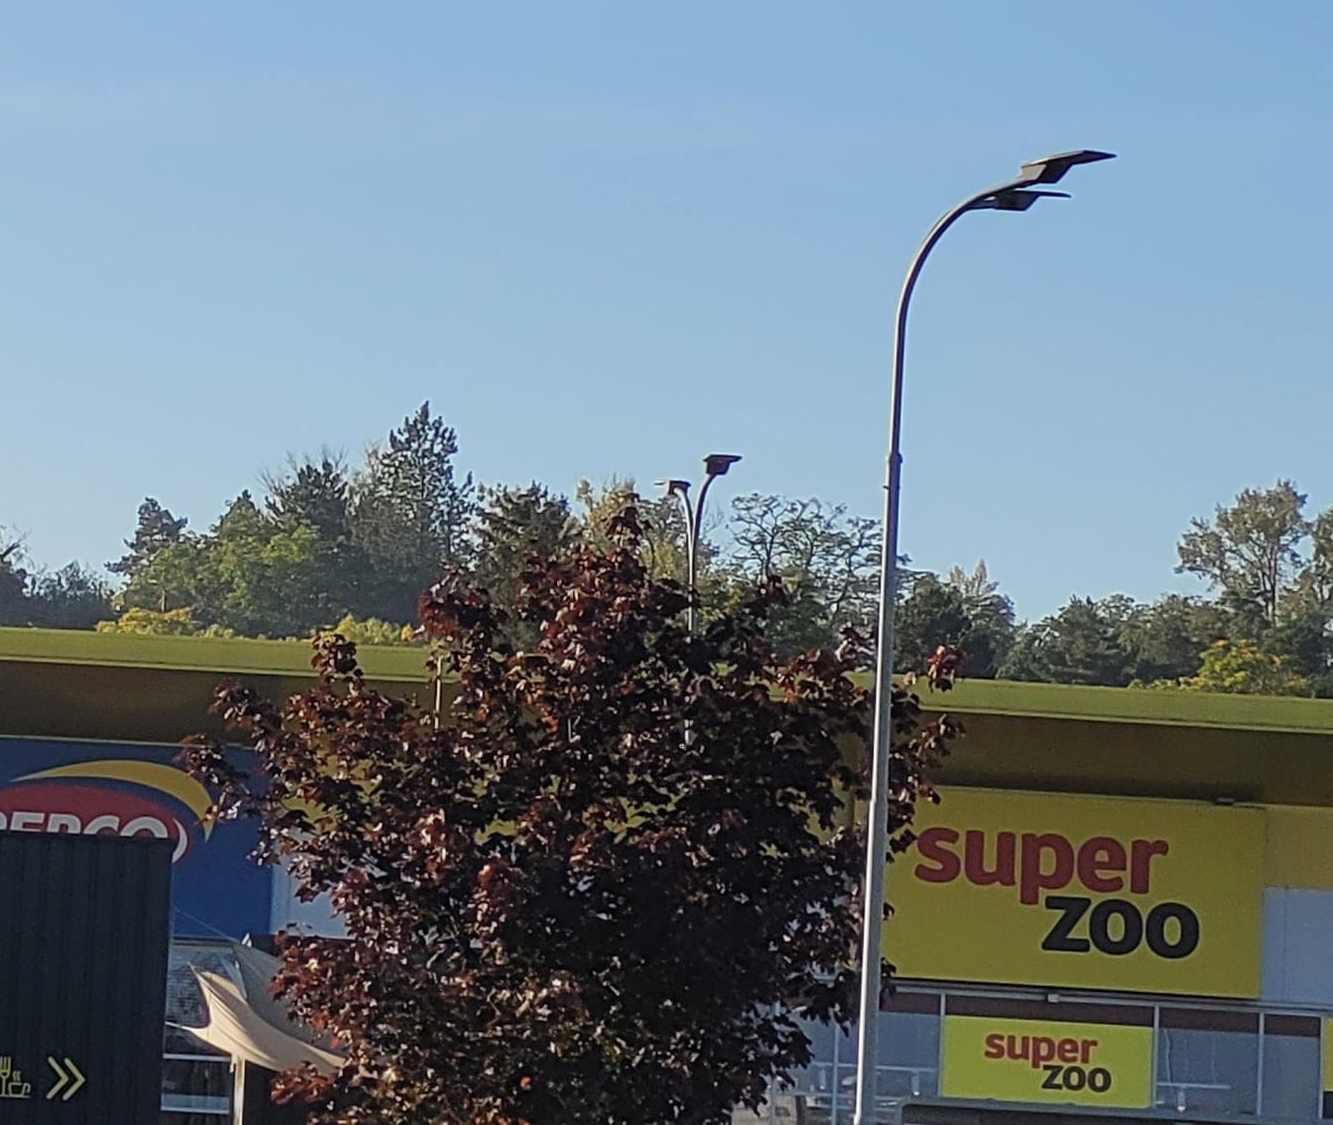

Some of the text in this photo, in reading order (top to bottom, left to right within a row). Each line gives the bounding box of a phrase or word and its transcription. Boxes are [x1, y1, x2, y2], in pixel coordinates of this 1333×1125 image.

[914, 827, 1169, 905] super
[1041, 896, 1200, 959] zoo
[984, 1033, 1098, 1068] super
[1041, 1065, 1111, 1093] zoo
